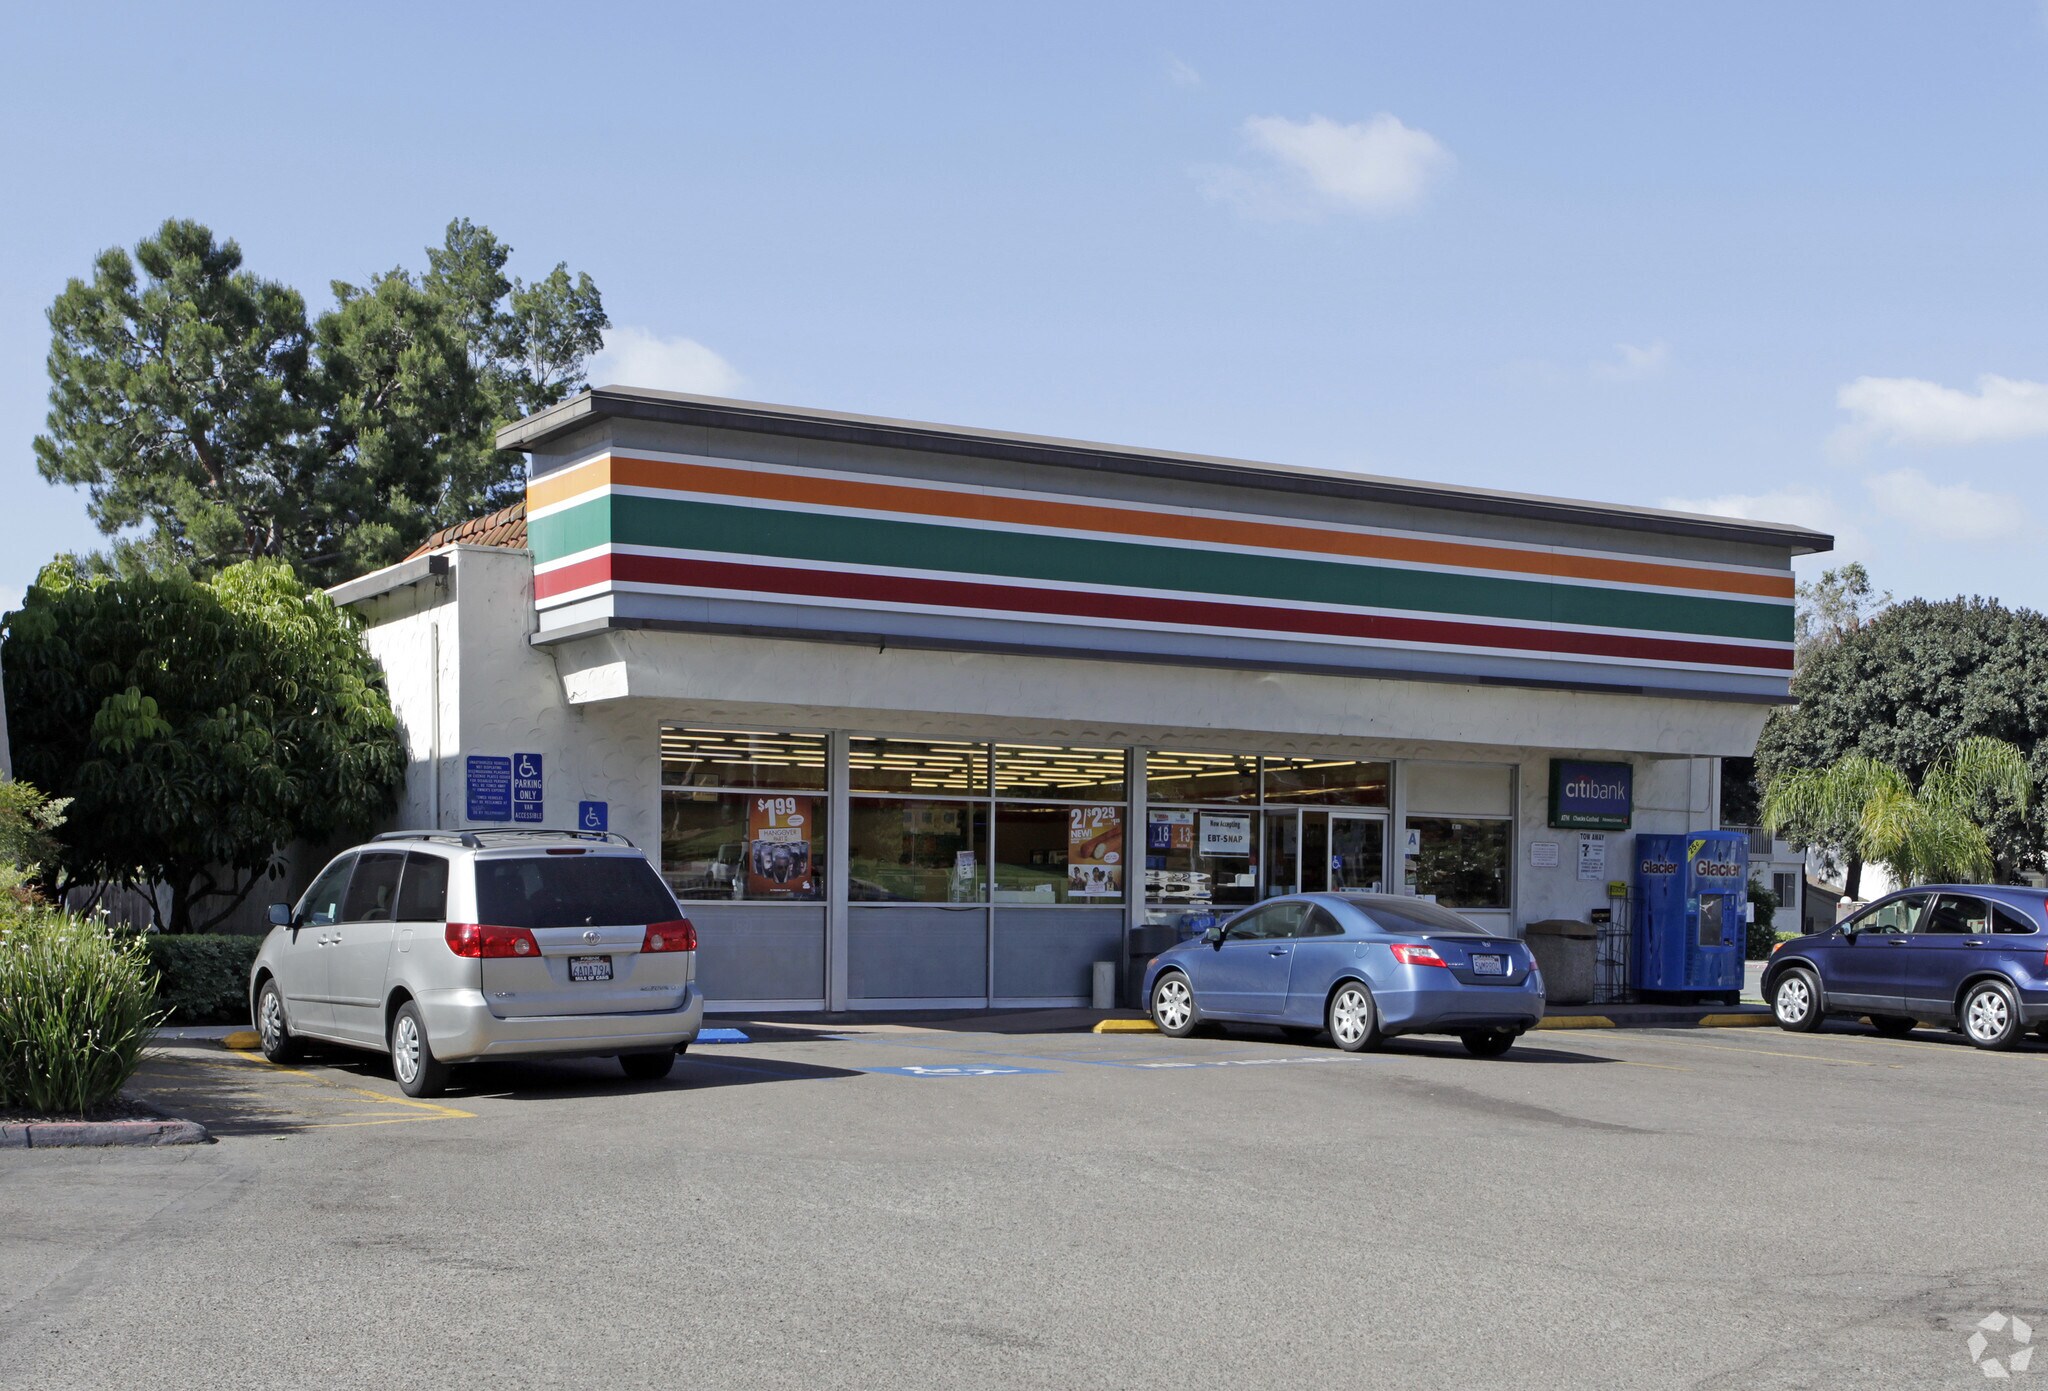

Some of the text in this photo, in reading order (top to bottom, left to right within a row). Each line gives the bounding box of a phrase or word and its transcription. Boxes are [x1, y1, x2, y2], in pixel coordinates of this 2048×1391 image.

[514, 778, 542, 788] PARKING
[1566, 780, 1624, 799] citibank
[520, 790, 536, 800] ONLY
[1220, 821, 1240, 829] Accepting
[1071, 829, 1092, 838] NEW!
[1158, 826, 1190, 842] 18 13
[1208, 834, 1242, 843] EBT-SNAP
[1580, 831, 1590, 840] TOW
[1408, 833, 1416, 845] A
[1641, 861, 1677, 874] Glacier
[1696, 860, 1740, 876] Glacier
